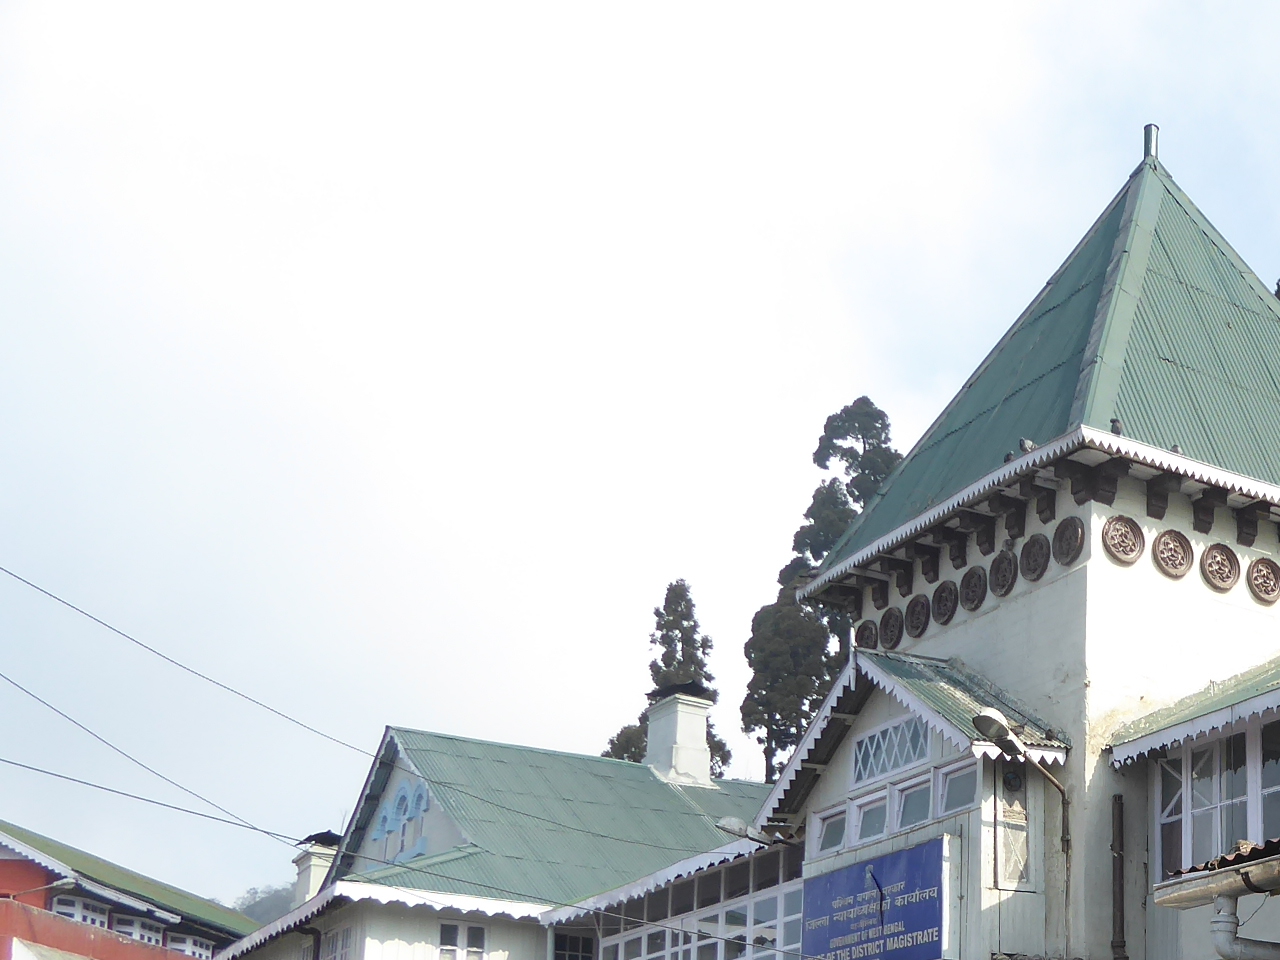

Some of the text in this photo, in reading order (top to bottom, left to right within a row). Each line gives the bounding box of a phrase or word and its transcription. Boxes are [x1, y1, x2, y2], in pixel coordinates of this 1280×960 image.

[894, 886, 938, 907] कार्यालय
[830, 921, 905, 949] GOVERNMENT OF WEST BENGAL
[836, 948, 851, 960] THE
[851, 940, 884, 959] DISTRICT
[886, 927, 939, 951] MAGISTRATE
